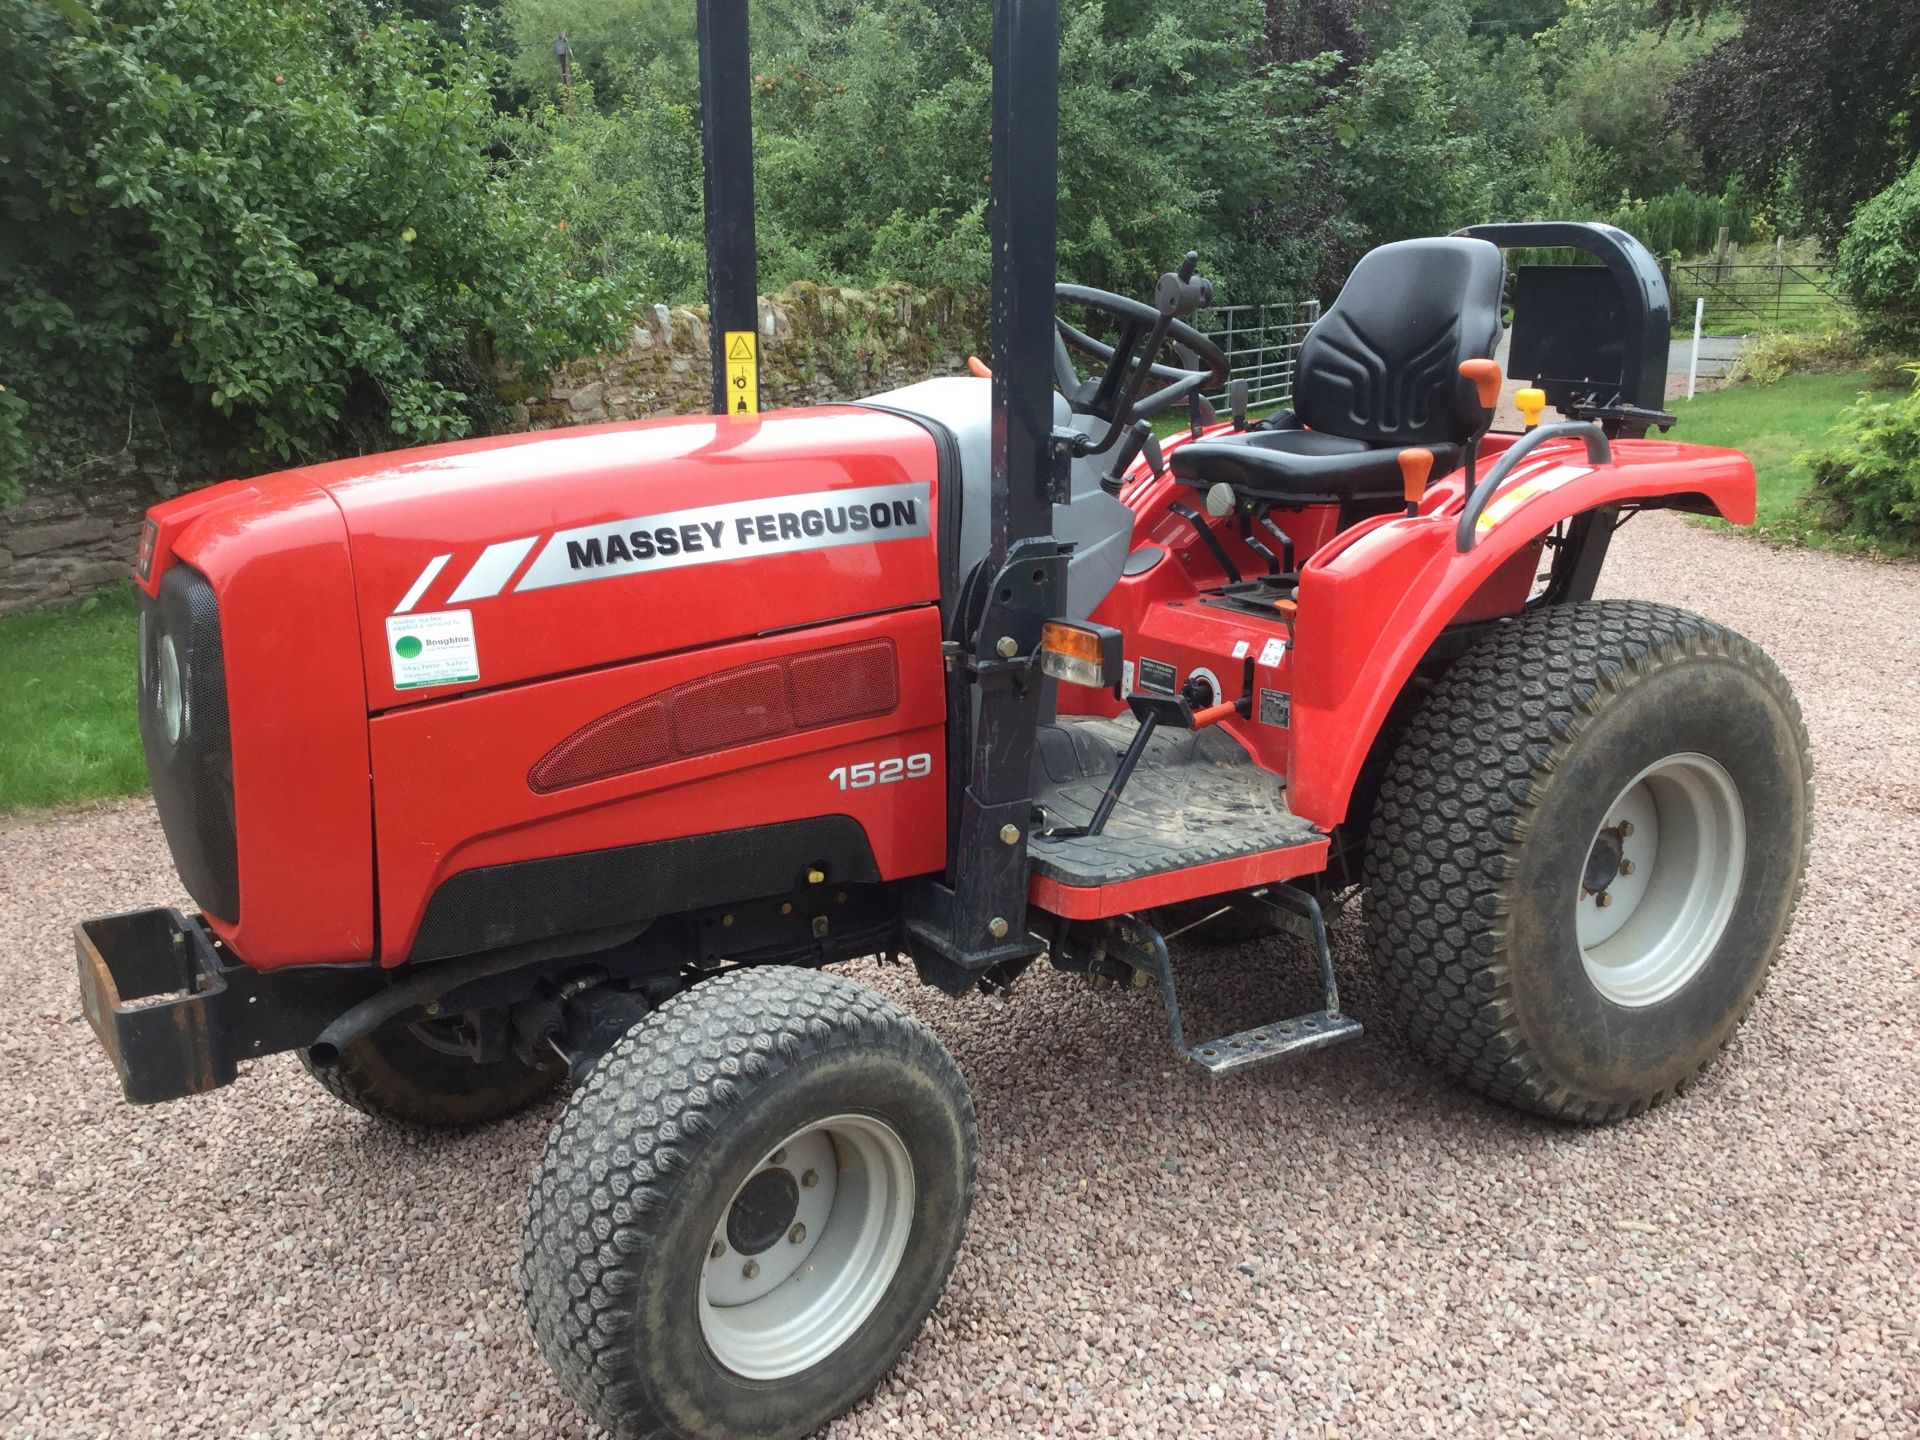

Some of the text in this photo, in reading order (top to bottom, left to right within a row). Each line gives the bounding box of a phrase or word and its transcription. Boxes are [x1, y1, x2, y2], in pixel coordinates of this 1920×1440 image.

[565, 499, 917, 570] MASSEY FERGUSON
[426, 636, 470, 646] Boughton
[828, 752, 932, 791] 1529
